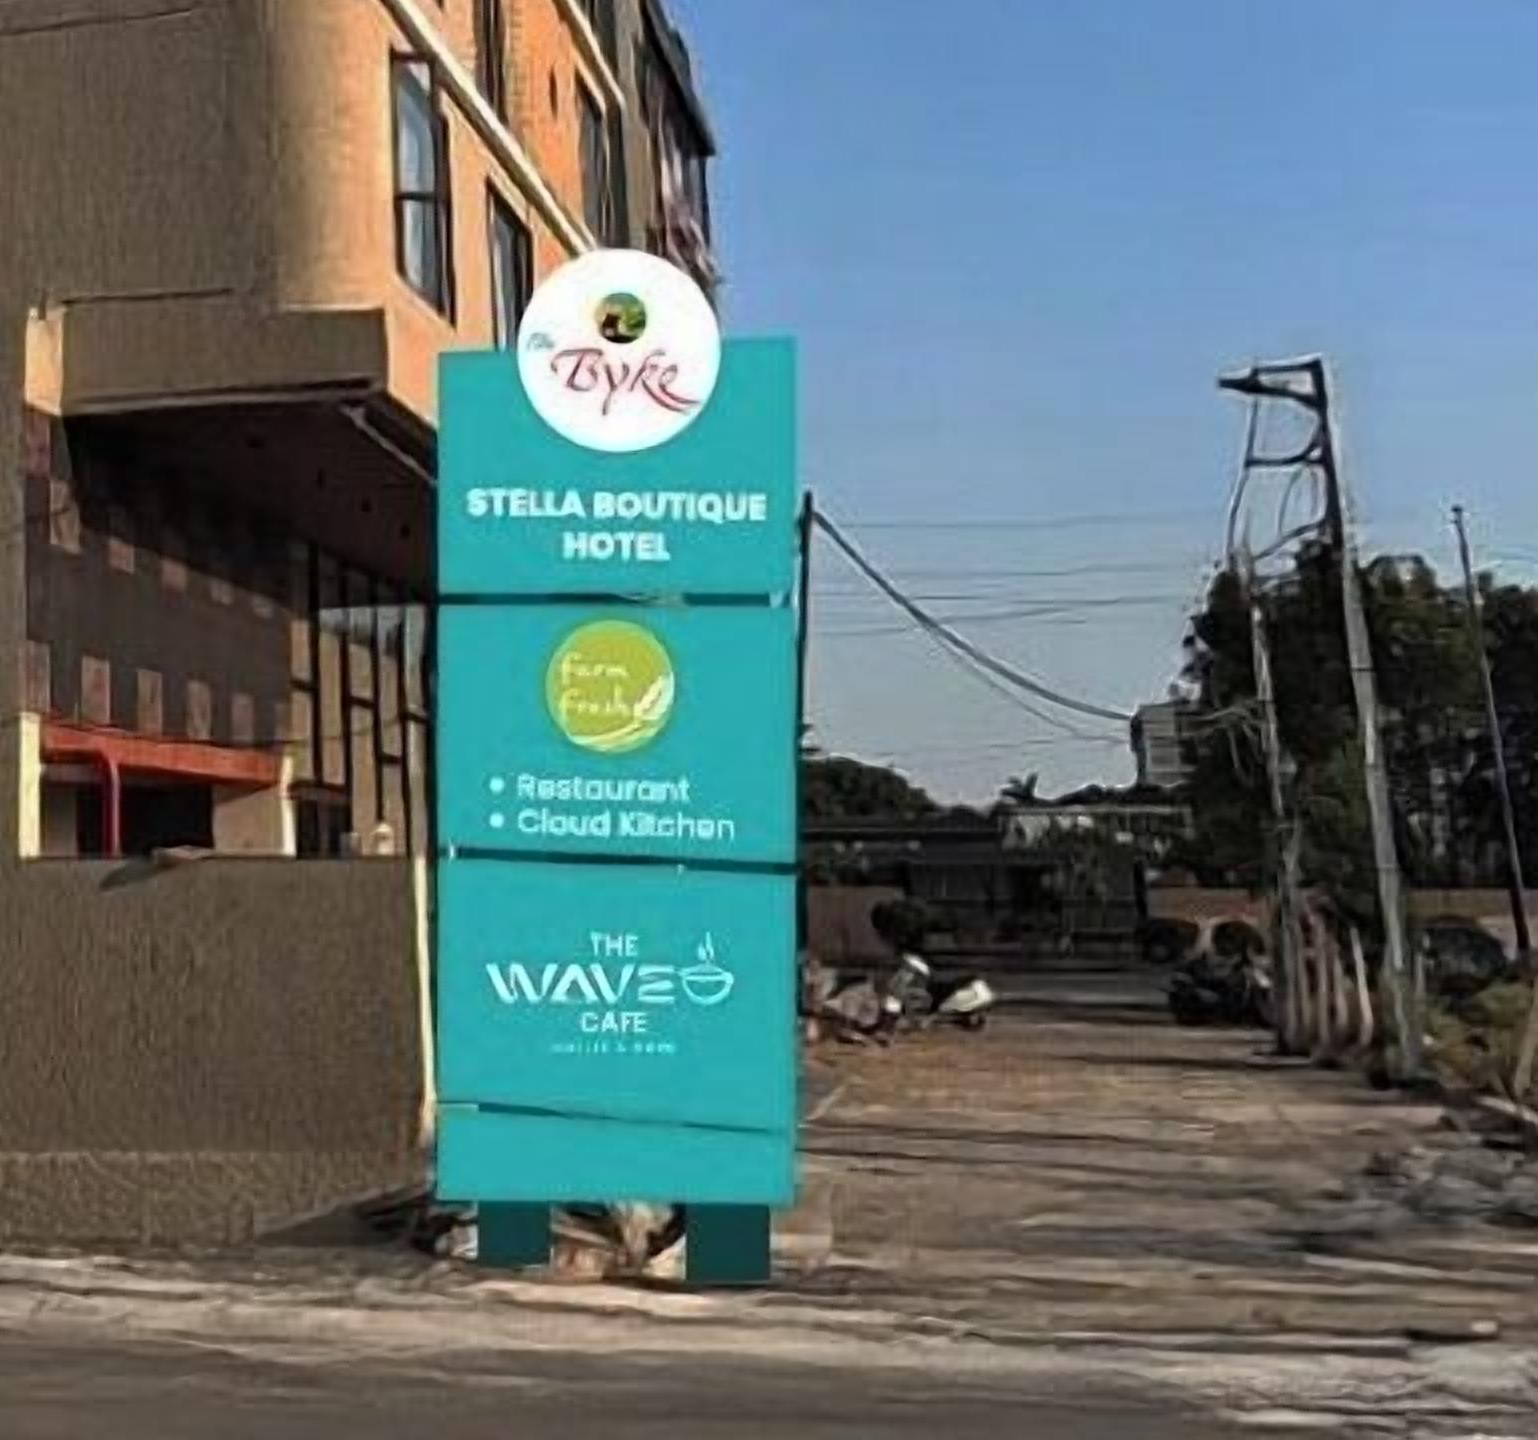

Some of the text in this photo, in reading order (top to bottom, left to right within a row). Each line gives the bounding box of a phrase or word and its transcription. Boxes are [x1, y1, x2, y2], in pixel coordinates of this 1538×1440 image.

[467, 488, 768, 525] STELLA BOUTIQUE
[562, 531, 671, 562] HOTEL
[517, 772, 691, 803] Restaurant
[517, 808, 736, 841] Cloud Kitchen
[589, 931, 639, 957] THE
[580, 1010, 649, 1034] CAFE
